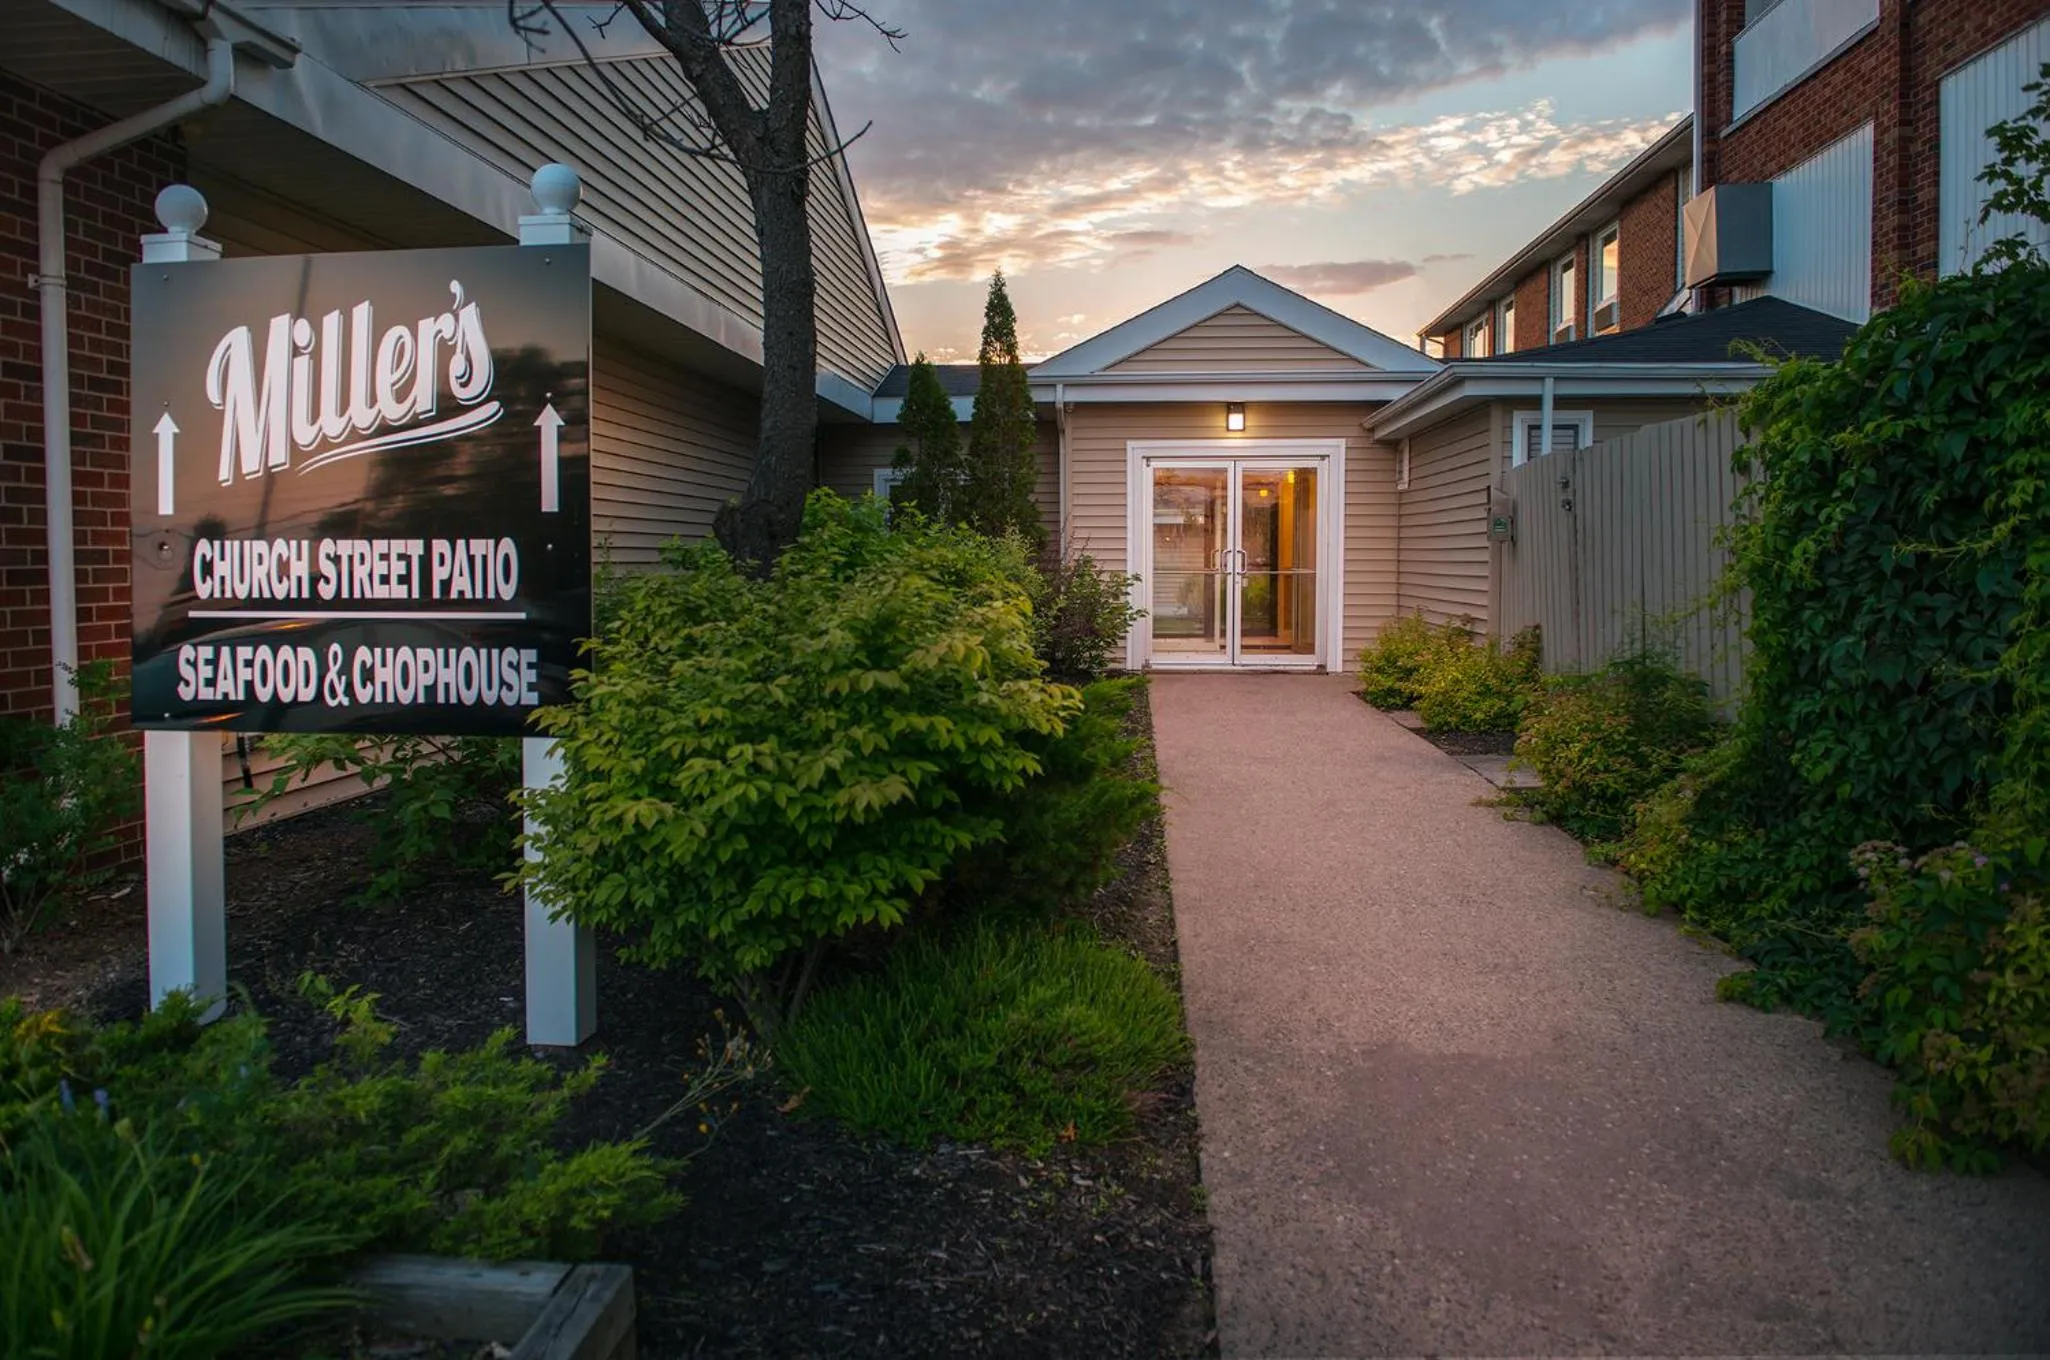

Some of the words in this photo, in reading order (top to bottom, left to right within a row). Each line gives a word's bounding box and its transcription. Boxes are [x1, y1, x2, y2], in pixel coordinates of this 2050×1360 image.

[206, 279, 496, 486] Miller's
[193, 537, 310, 600] CHURCH
[317, 537, 424, 600] STREET
[432, 536, 519, 601] PATIO
[177, 644, 318, 702] SEAFOOD
[323, 643, 350, 707] &
[353, 645, 539, 706] CHOPHOUSE
